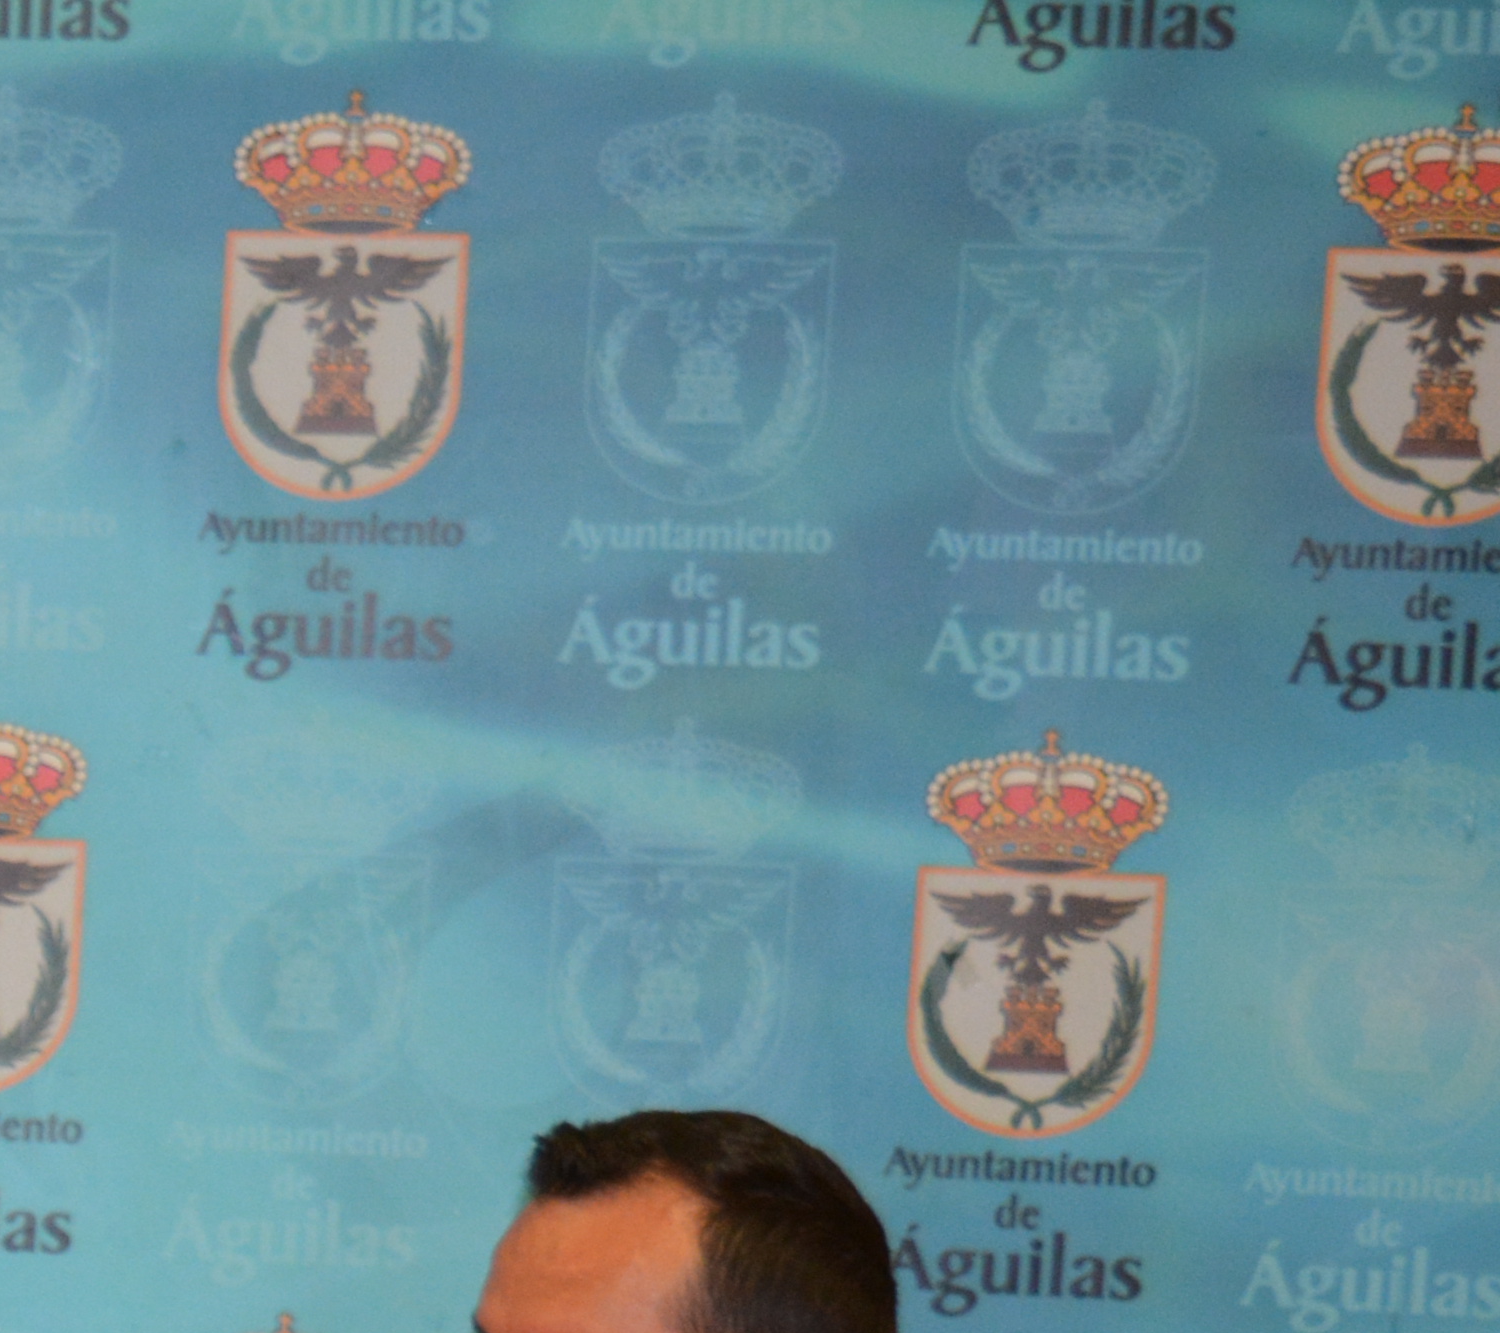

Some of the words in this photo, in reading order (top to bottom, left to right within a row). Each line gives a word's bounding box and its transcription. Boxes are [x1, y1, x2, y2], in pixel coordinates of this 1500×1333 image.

[198, 510, 466, 553] Ayuntamiento
[307, 556, 351, 594] de
[1404, 583, 1452, 622] de
[197, 599, 454, 681] Águilas
[558, 600, 821, 690] Águilas
[924, 609, 1189, 700] Águilas
[1288, 624, 1500, 713] Águila
[885, 1146, 1157, 1189] Ayuntamiento
[994, 1195, 1040, 1231] de
[891, 1224, 1143, 1316] Águilas
